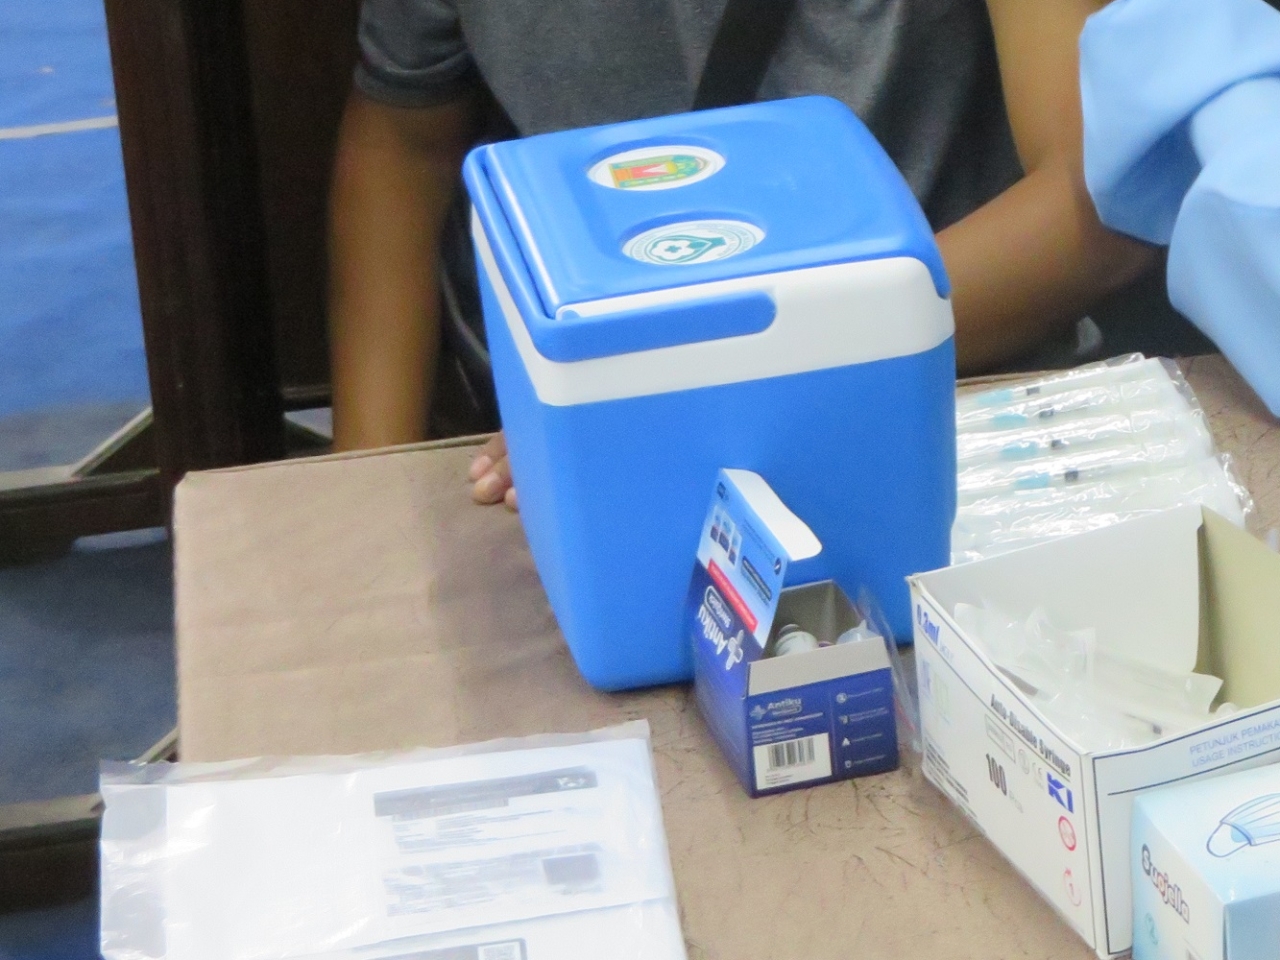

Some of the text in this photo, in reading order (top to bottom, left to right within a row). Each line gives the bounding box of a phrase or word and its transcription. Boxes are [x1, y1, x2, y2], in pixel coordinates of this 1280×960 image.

[697, 602, 728, 656] Antiku
[767, 697, 802, 711] Antiku
[1189, 733, 1238, 755] PETUNJUK
[1192, 750, 1226, 768] USAGE
[985, 753, 1007, 796] 100
[1141, 843, 1190, 925] Suojella
